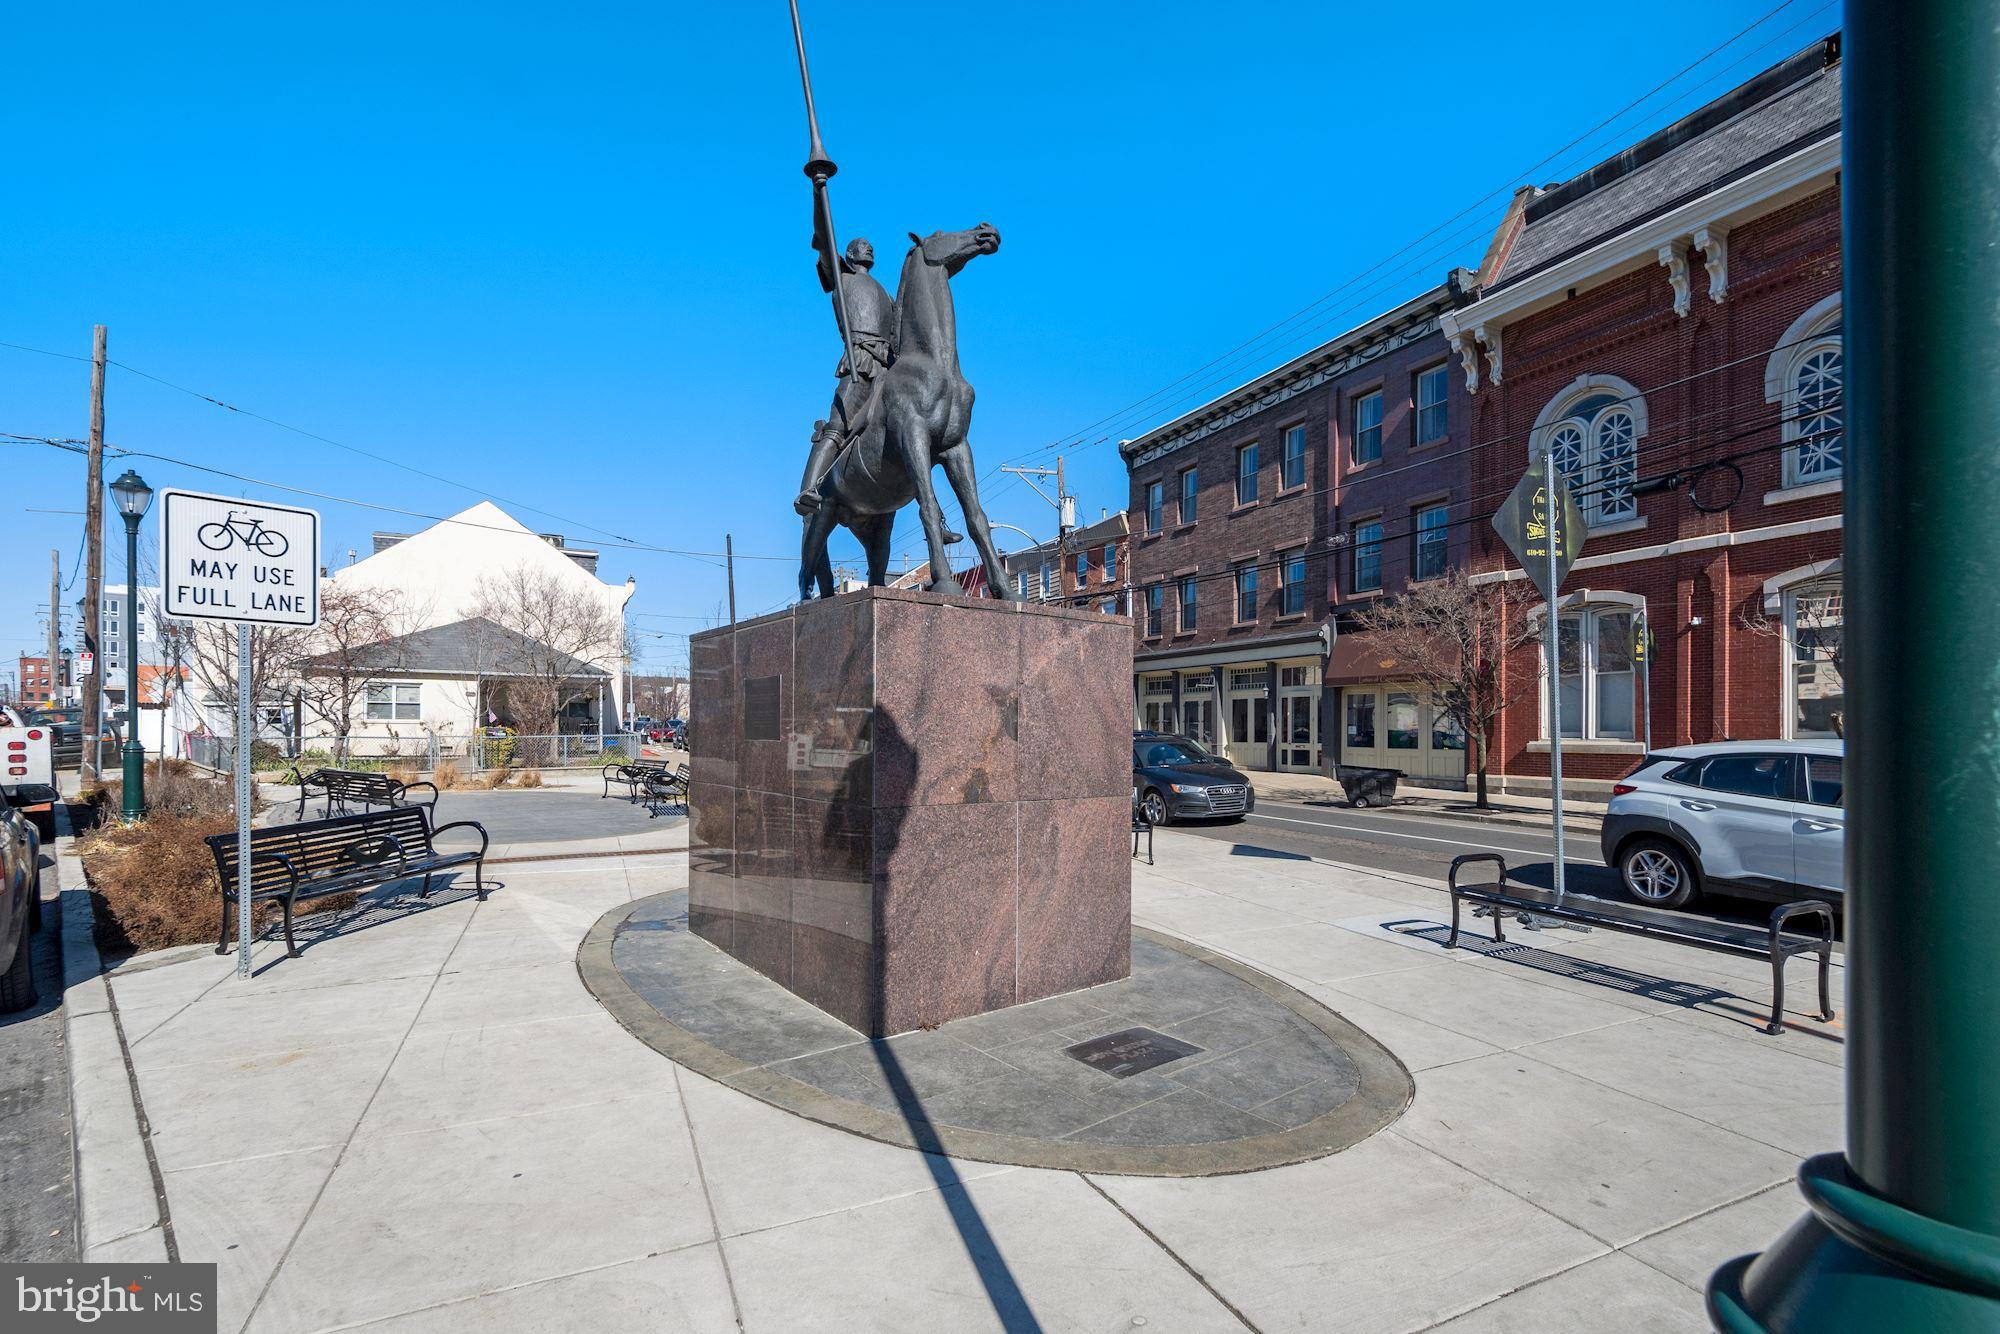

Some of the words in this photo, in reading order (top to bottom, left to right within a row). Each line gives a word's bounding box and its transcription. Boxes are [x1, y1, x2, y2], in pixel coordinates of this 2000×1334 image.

[190, 558, 238, 580] MAY
[254, 565, 295, 586] USE
[178, 585, 236, 608] FULL
[251, 592, 306, 614] LANE
